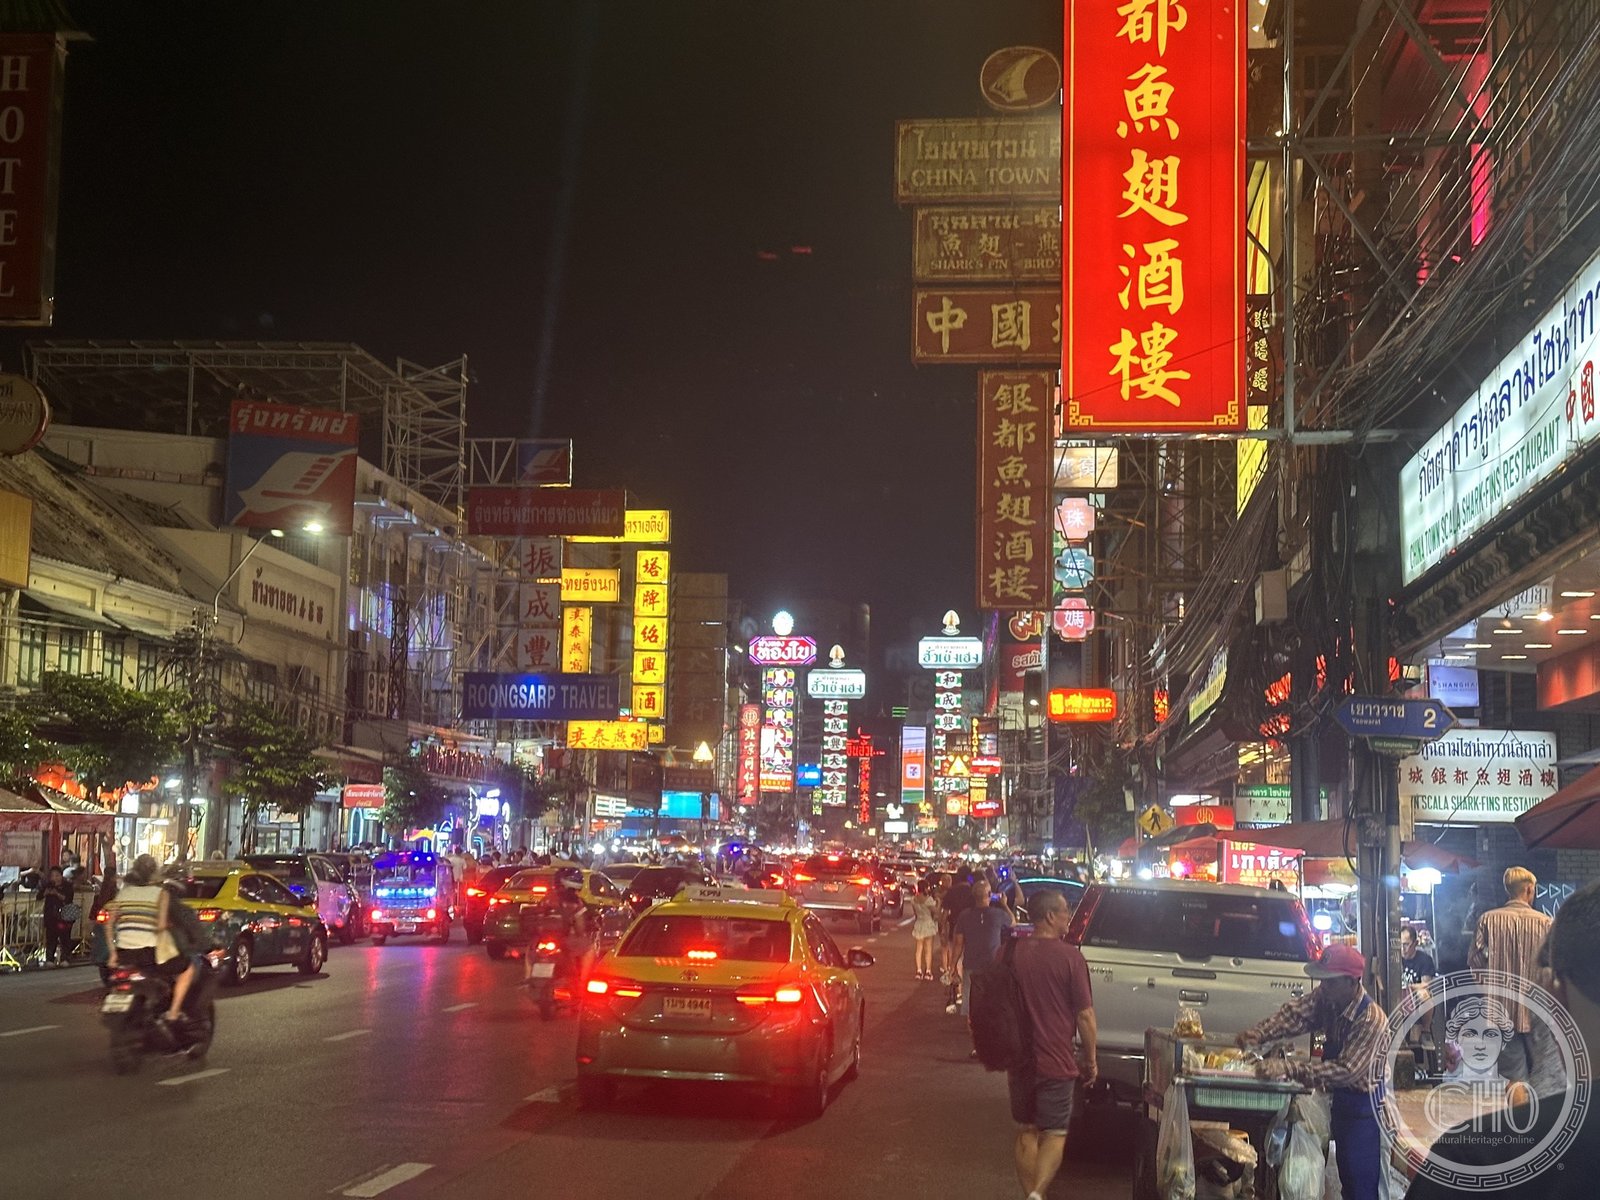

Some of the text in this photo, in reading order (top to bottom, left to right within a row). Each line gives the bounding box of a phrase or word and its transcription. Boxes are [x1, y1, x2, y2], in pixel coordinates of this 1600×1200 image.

[0, 56, 29, 298] HOTEL
[911, 168, 976, 187] CHINA
[985, 166, 1050, 185] TOWN
[1108, 0, 1191, 407] 都魚翅酒樓
[988, 258, 1008, 269] FIN
[1024, 257, 1061, 268] BIRD'
[926, 296, 1061, 355] 中國
[1419, 278, 1600, 502] ภัตตาคารหูฉลามไชน่าท
[1565, 360, 1600, 442] 中國
[988, 382, 1039, 601] 銀都魚翅酒樓
[1410, 538, 1425, 570] CHINA
[1425, 525, 1441, 556] TOWN
[1441, 503, 1461, 544] SCALA
[1502, 414, 1561, 492] RESTAURANT
[523, 544, 559, 667] 振成豐
[468, 684, 615, 709] ROONGSARP TRAVEL
[1350, 703, 1437, 729] เยาวราช 2
[1352, 717, 1382, 726] Yaowarat
[829, 701, 843, 804] 和成興大金行
[1399, 766, 1556, 787] 城銀都魚翅酒樓
[1422, 796, 1449, 811] SCALA
[1452, 796, 1500, 812] SHARK-FINS
[699, 889, 721, 897] KPN
